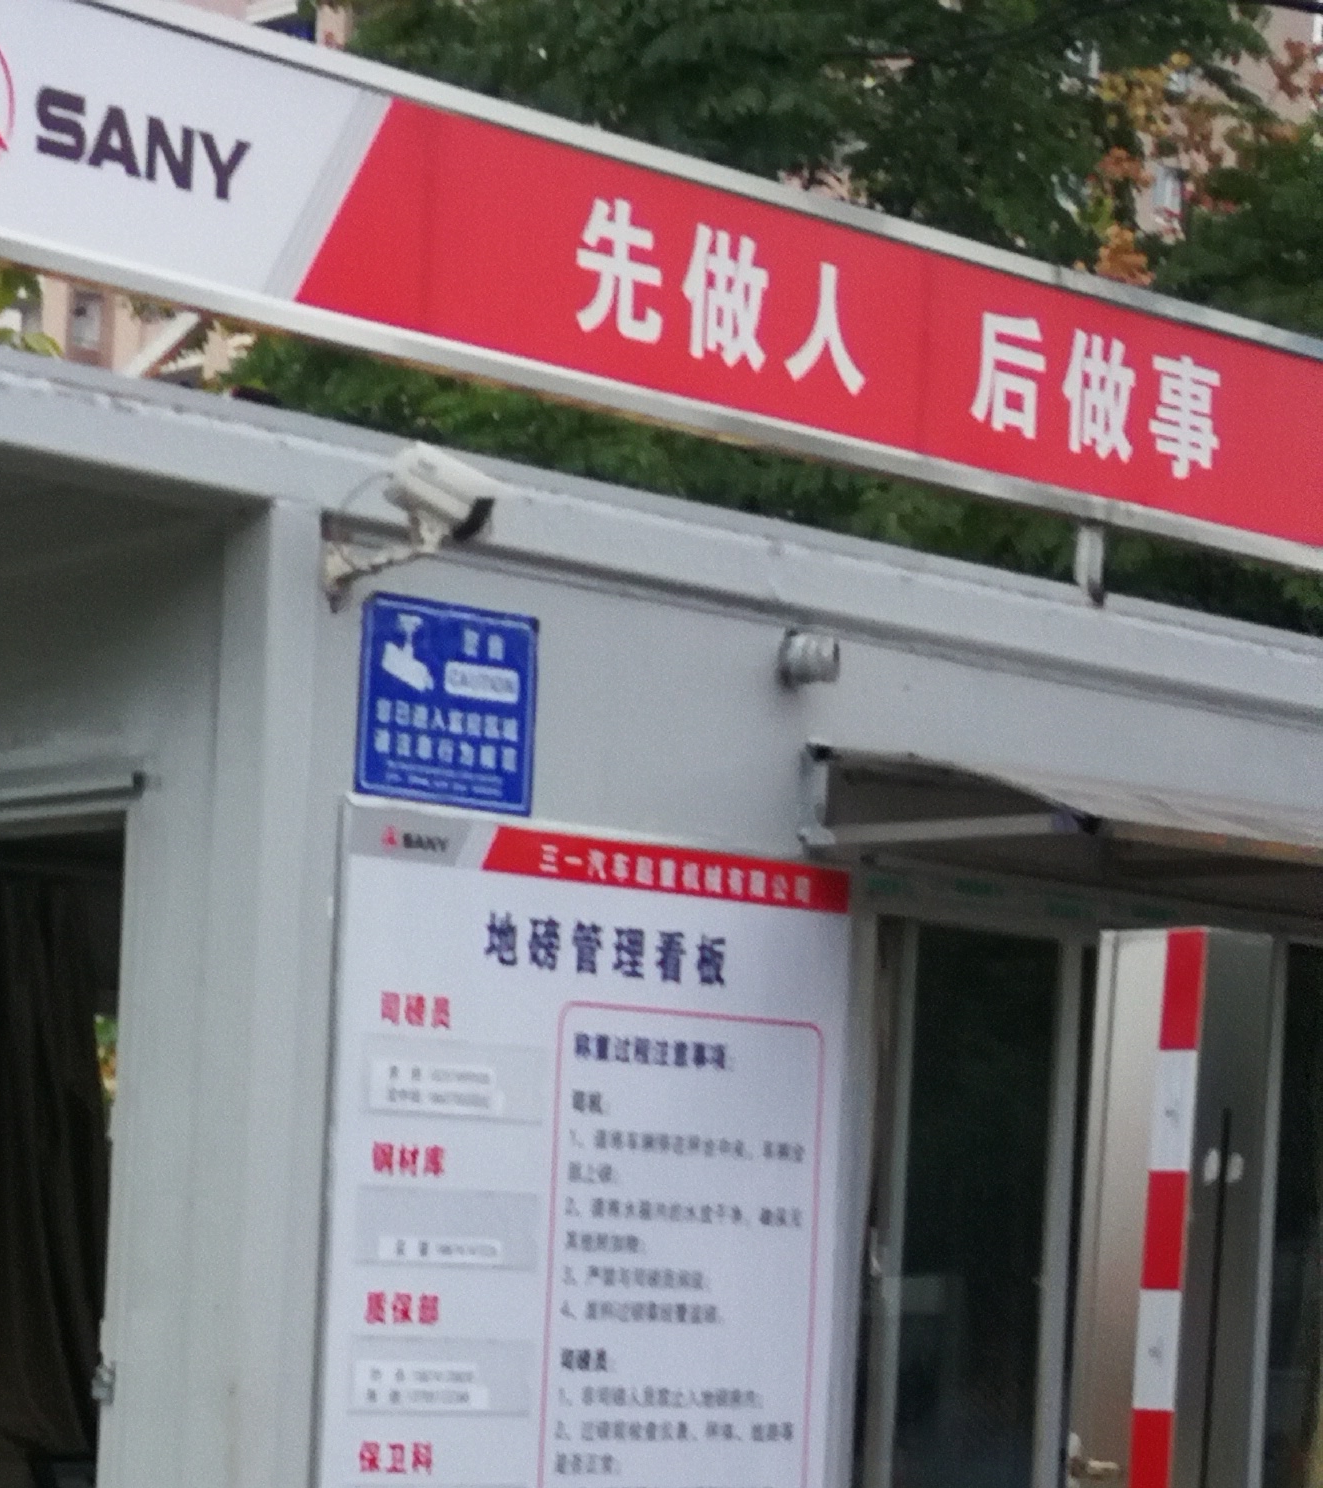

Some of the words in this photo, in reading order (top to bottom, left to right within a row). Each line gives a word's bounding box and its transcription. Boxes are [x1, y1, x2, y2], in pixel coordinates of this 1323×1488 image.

[34, 85, 252, 202] SANY
[574, 197, 867, 397] 先做人
[970, 310, 1222, 480] 后做事
[484, 910, 727, 986] 地磅管理看板
[372, 1140, 445, 1178] 钢材库
[364, 1290, 440, 1326] 质保部
[358, 1439, 433, 1476] 保卫科
